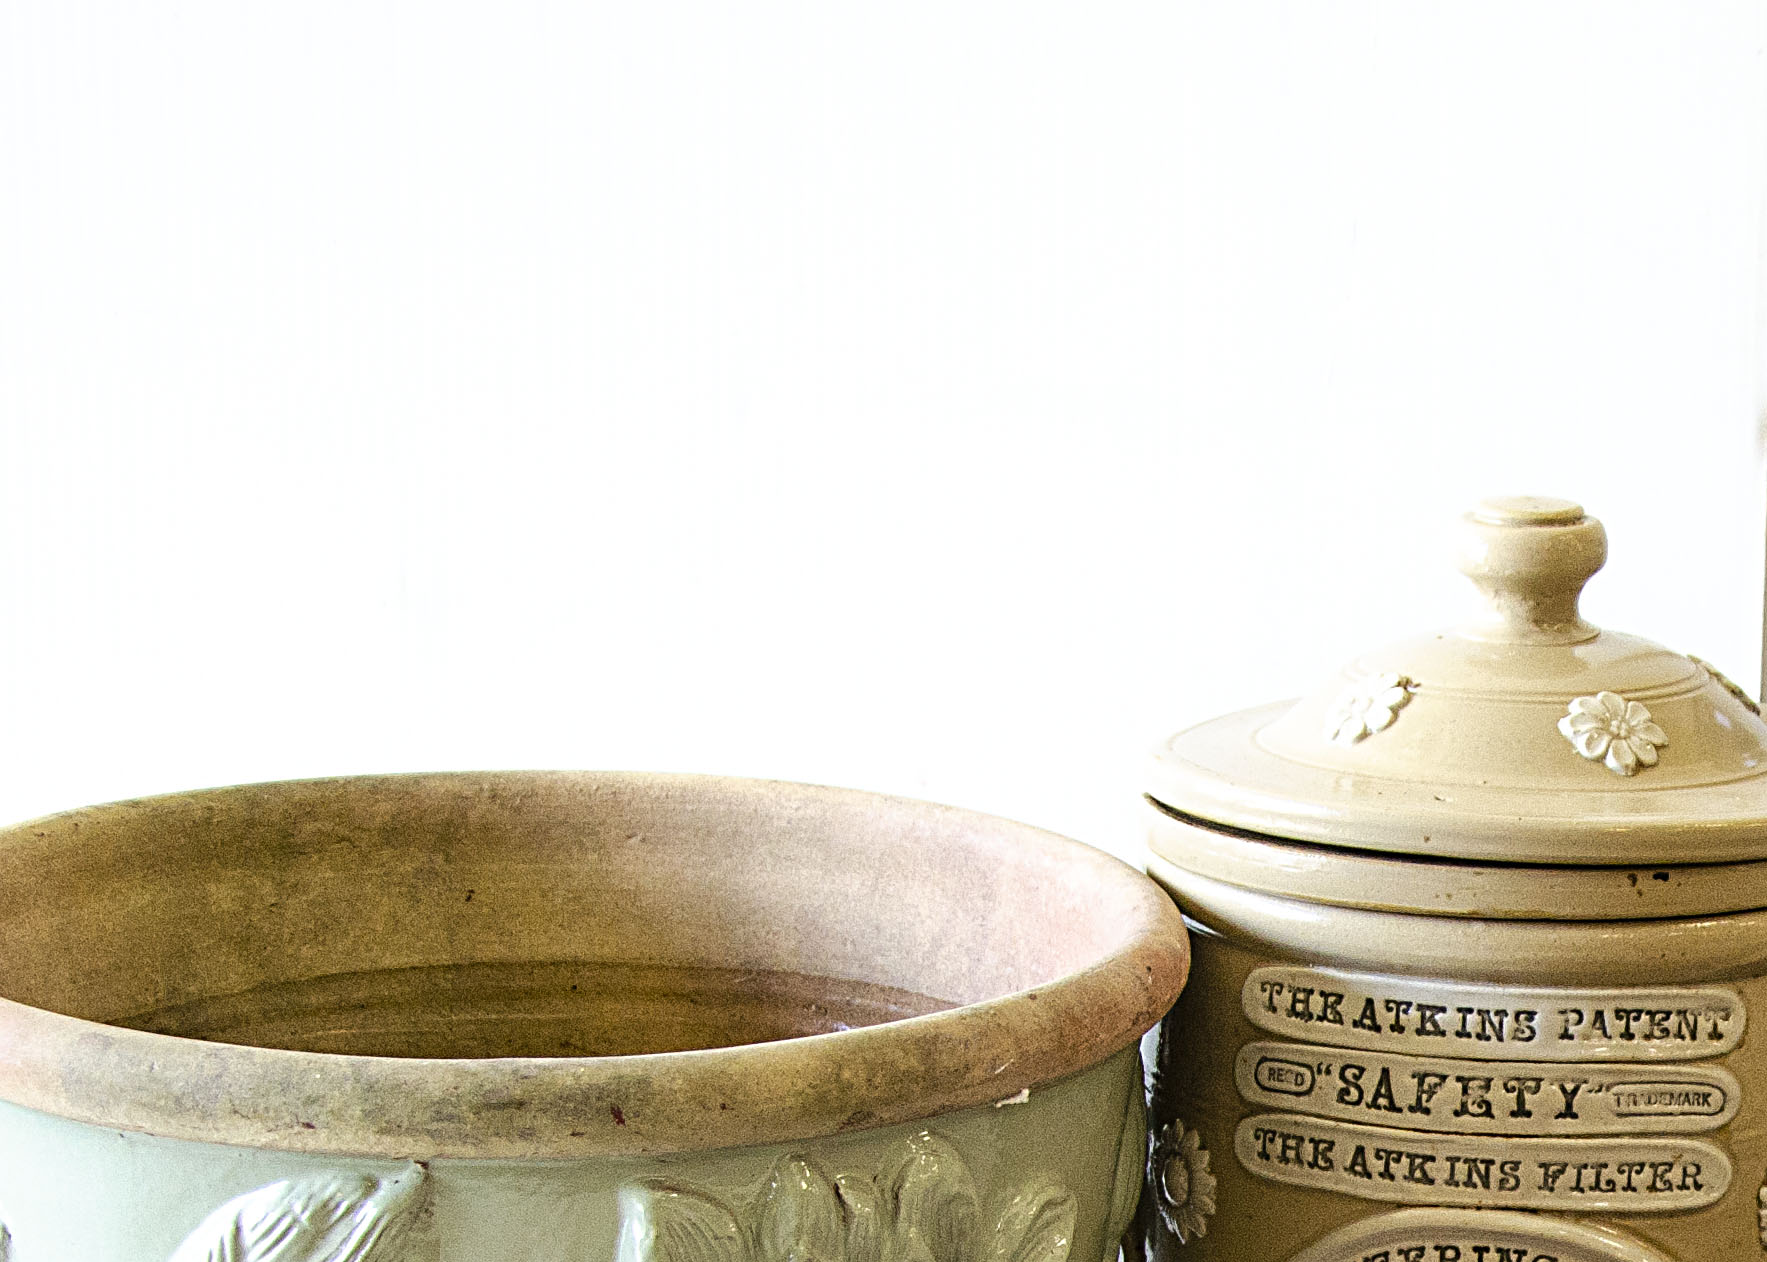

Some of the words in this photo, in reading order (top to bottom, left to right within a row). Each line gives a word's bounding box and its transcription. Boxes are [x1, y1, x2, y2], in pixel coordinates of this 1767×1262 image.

[1260, 980, 1344, 1027] THE
[1352, 997, 1539, 1042] ATKINS
[1558, 1006, 1731, 1042] PATENT
[1253, 1126, 1335, 1171] THE
[1343, 1144, 1522, 1192] ATKINS
[1537, 1159, 1704, 1194] FILTER
